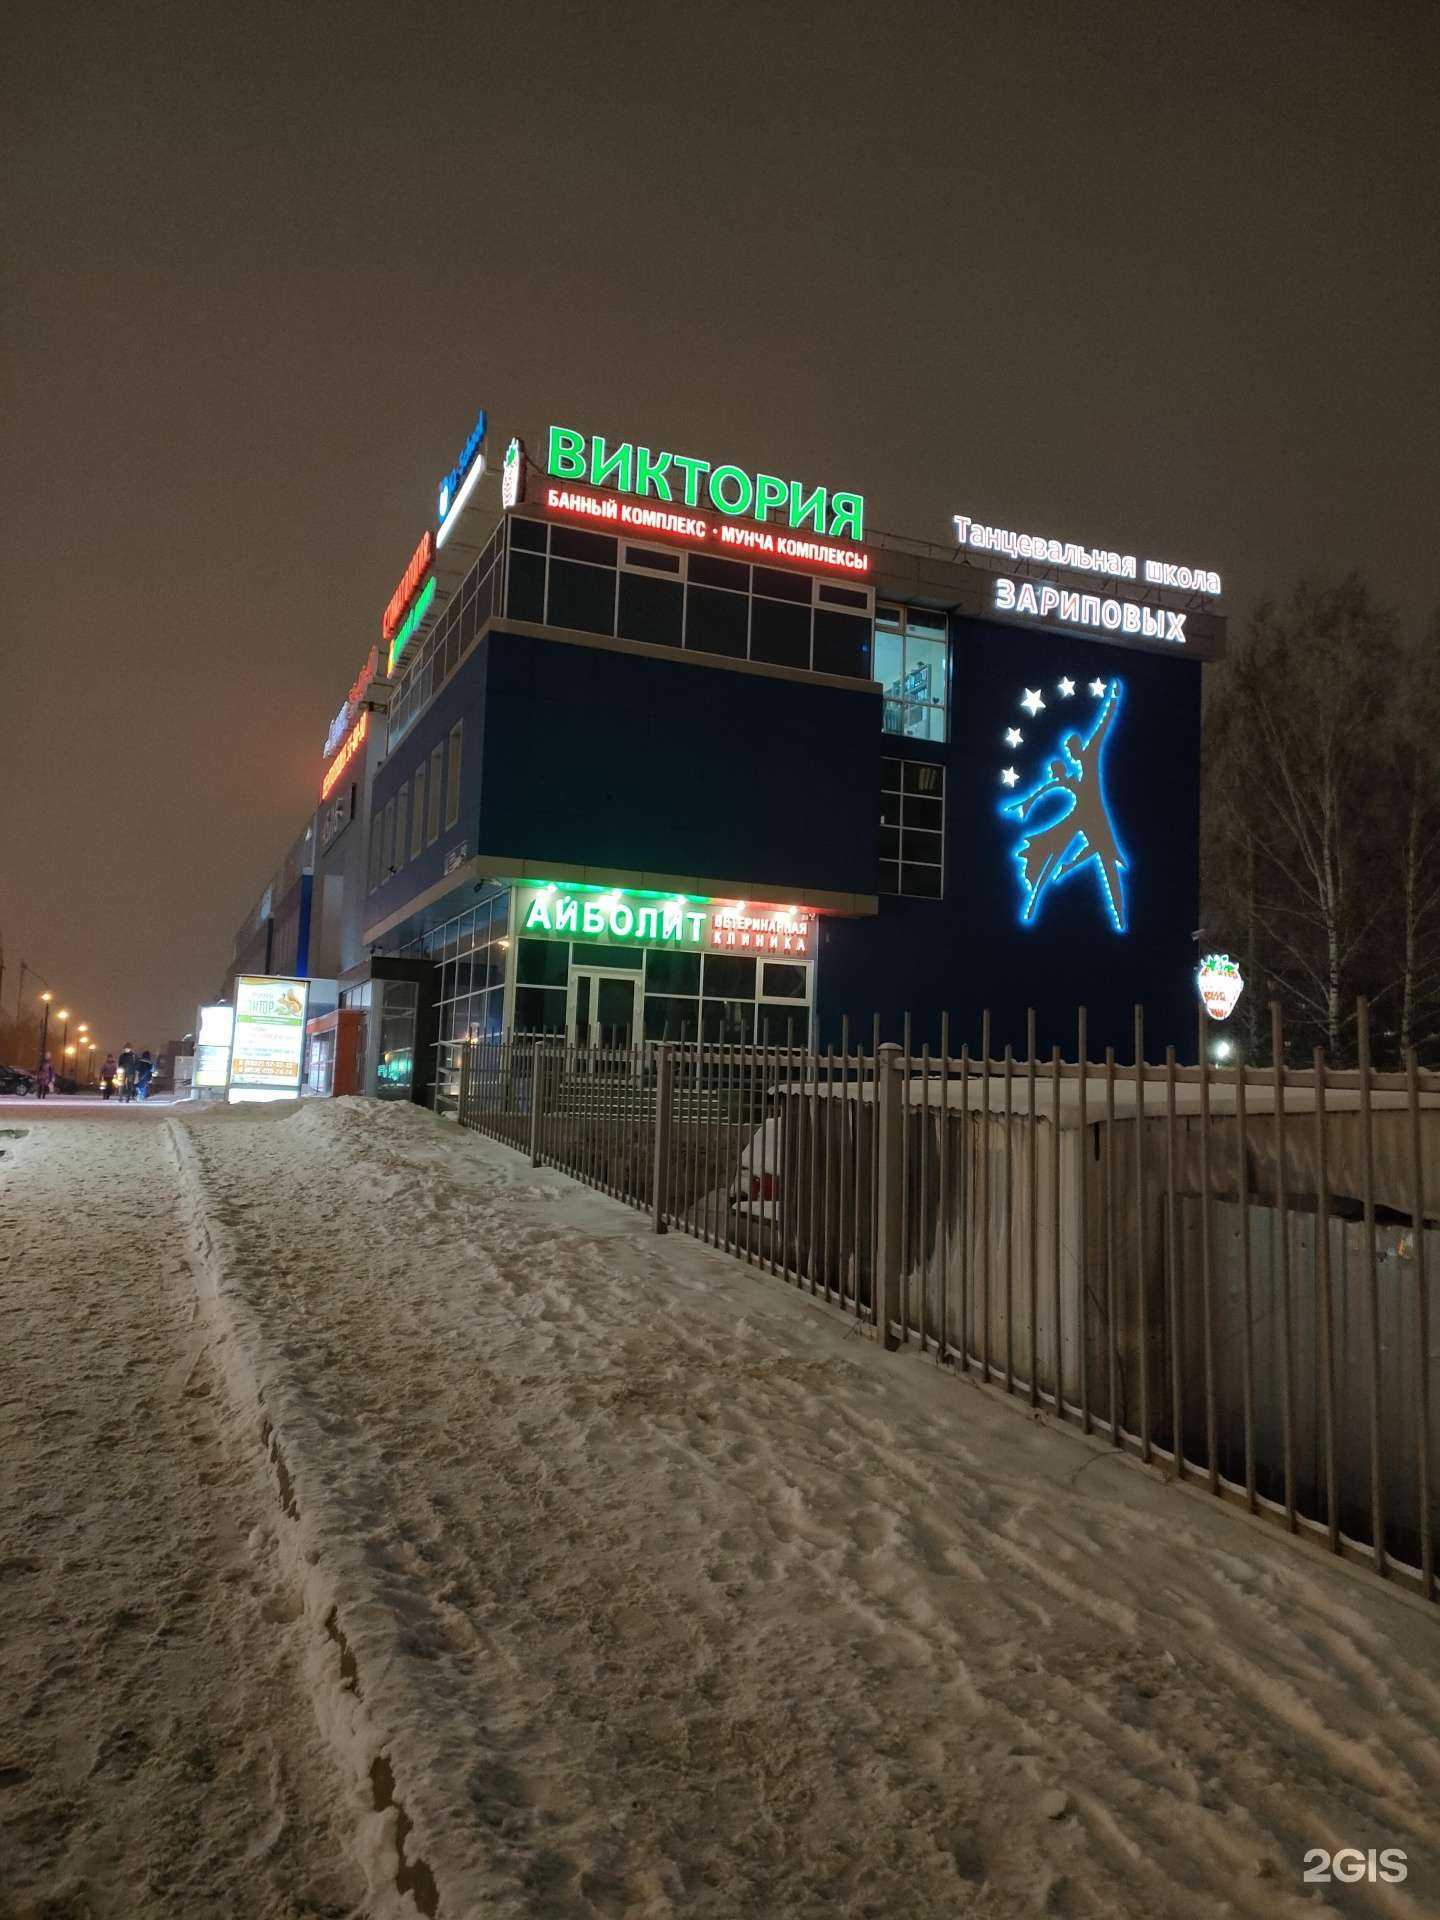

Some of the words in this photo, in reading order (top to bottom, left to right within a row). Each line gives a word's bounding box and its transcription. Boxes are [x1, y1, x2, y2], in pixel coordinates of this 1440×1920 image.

[547, 425, 864, 542] ВИКТОРИЯ
[548, 489, 618, 520] БАННЫЙ
[621, 504, 706, 538] КОМПЛЕКС
[721, 525, 773, 551] МУНЧА
[777, 536, 868, 570] КОМПЛЕКСЫ
[954, 515, 1136, 579] Танцевальная
[1145, 559, 1221, 594] школа
[996, 578, 1186, 643] ЗАРИПОВЫХ
[526, 892, 707, 943] АЙБОЛИТ
[714, 913, 808, 936] ВЕТЕРИНАРНАЯ
[714, 931, 806, 952] КЛИНИКА
